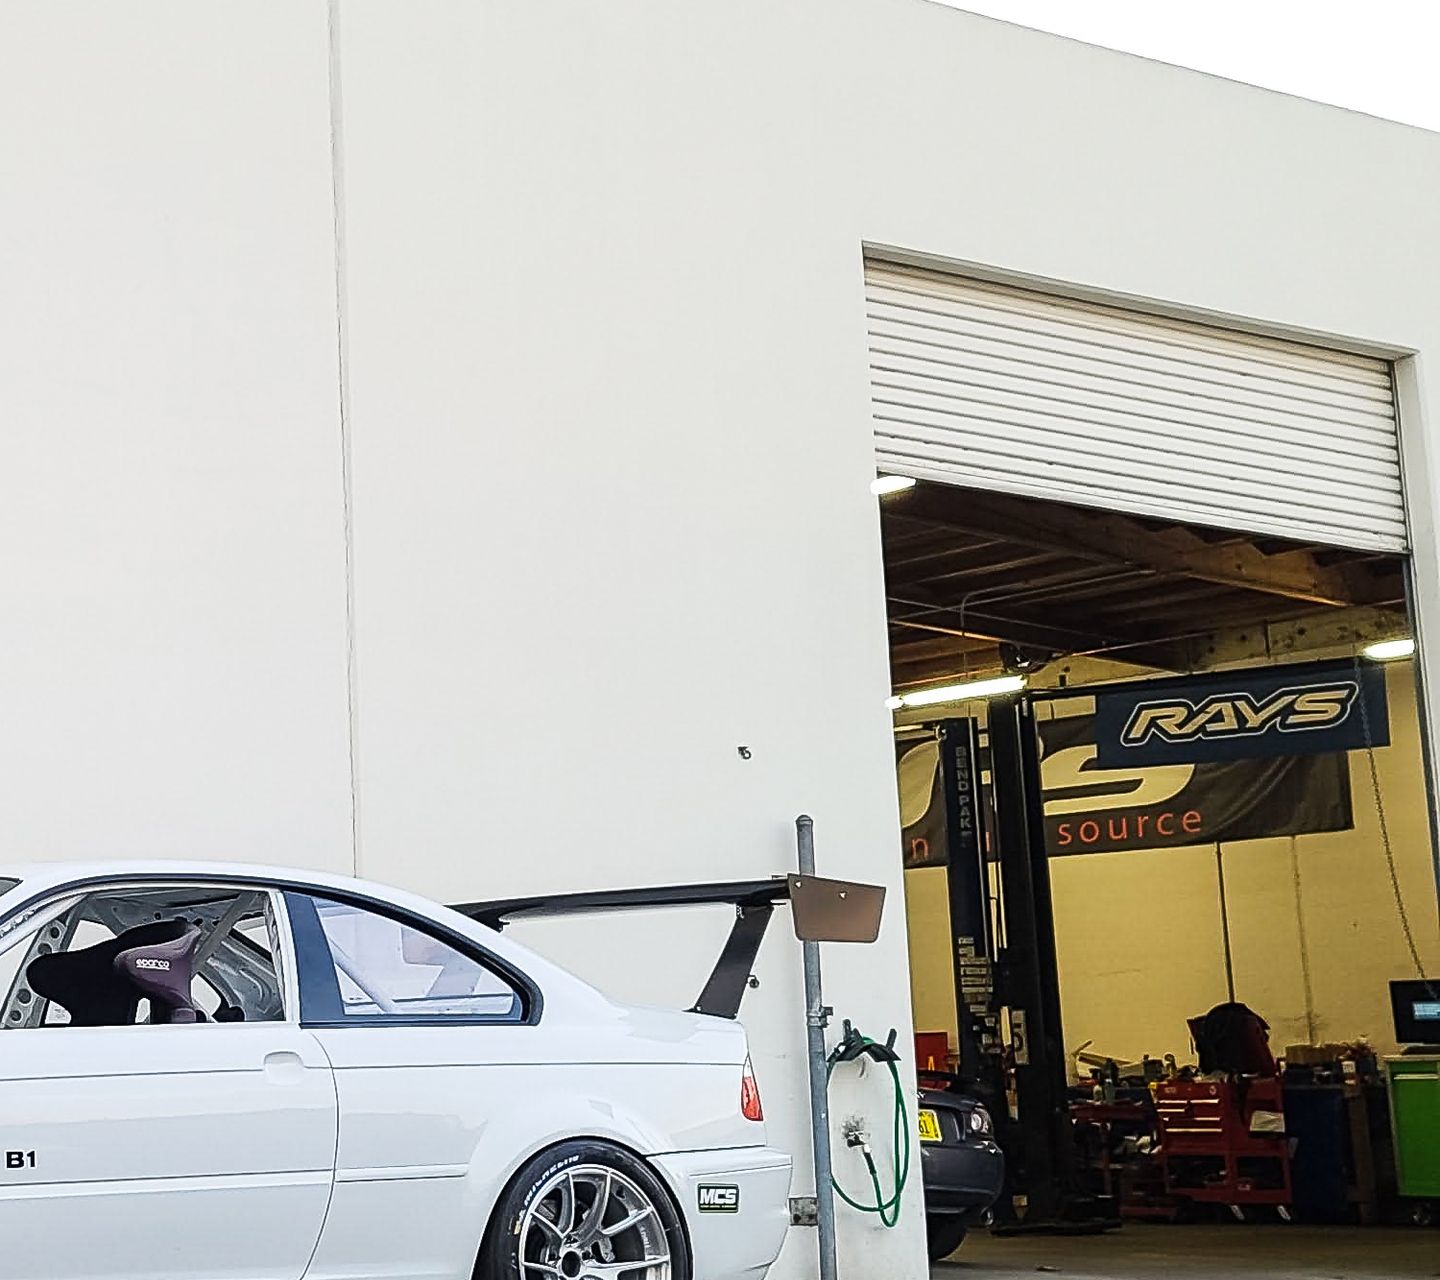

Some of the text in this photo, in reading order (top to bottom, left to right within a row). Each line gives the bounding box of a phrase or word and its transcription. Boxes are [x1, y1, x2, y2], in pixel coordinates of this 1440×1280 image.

[1125, 685, 1354, 741] RAYS
[1057, 809, 1202, 846] source
[6, 1151, 35, 1168] B1
[699, 1188, 737, 1204] MCS
